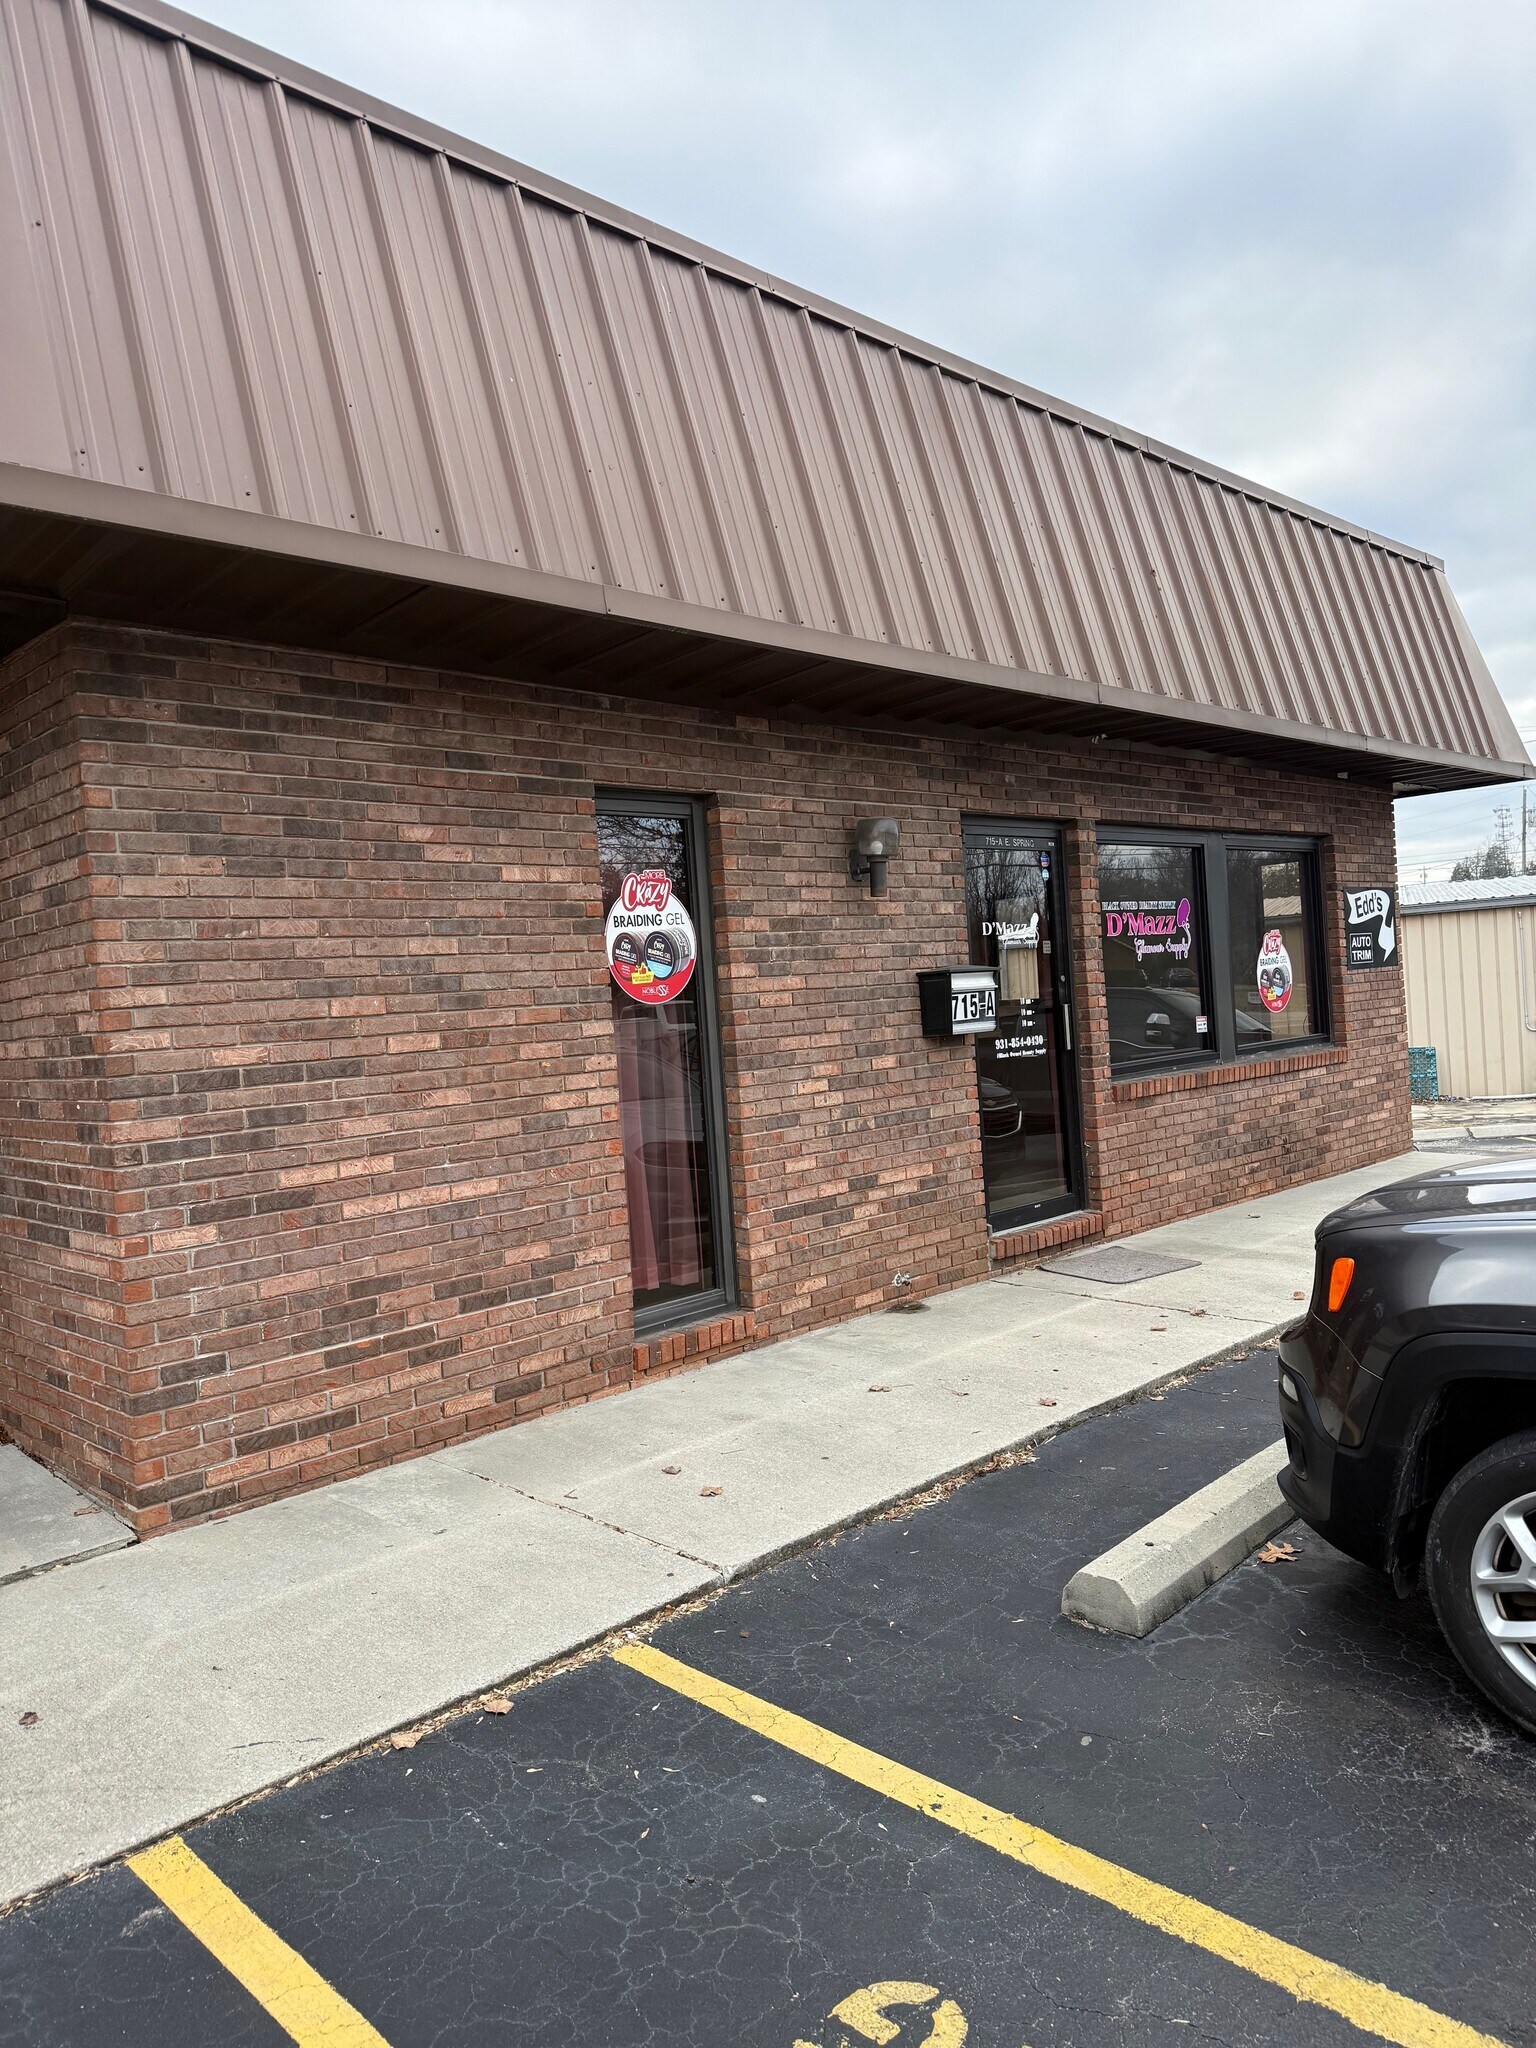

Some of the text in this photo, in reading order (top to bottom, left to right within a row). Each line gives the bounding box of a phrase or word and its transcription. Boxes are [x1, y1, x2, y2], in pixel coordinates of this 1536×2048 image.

[985, 837, 1003, 846] 715-A
[1012, 838, 1035, 848] SPRING
[1354, 892, 1383, 918] Edd's
[613, 912, 685, 928] BRAIDING GEL
[1106, 912, 1177, 937] D'Mazz
[982, 921, 1028, 936] D'Mazz
[1351, 936, 1371, 948] AUTO
[1351, 949, 1372, 961] TRIM
[951, 991, 995, 1020] 715-A
